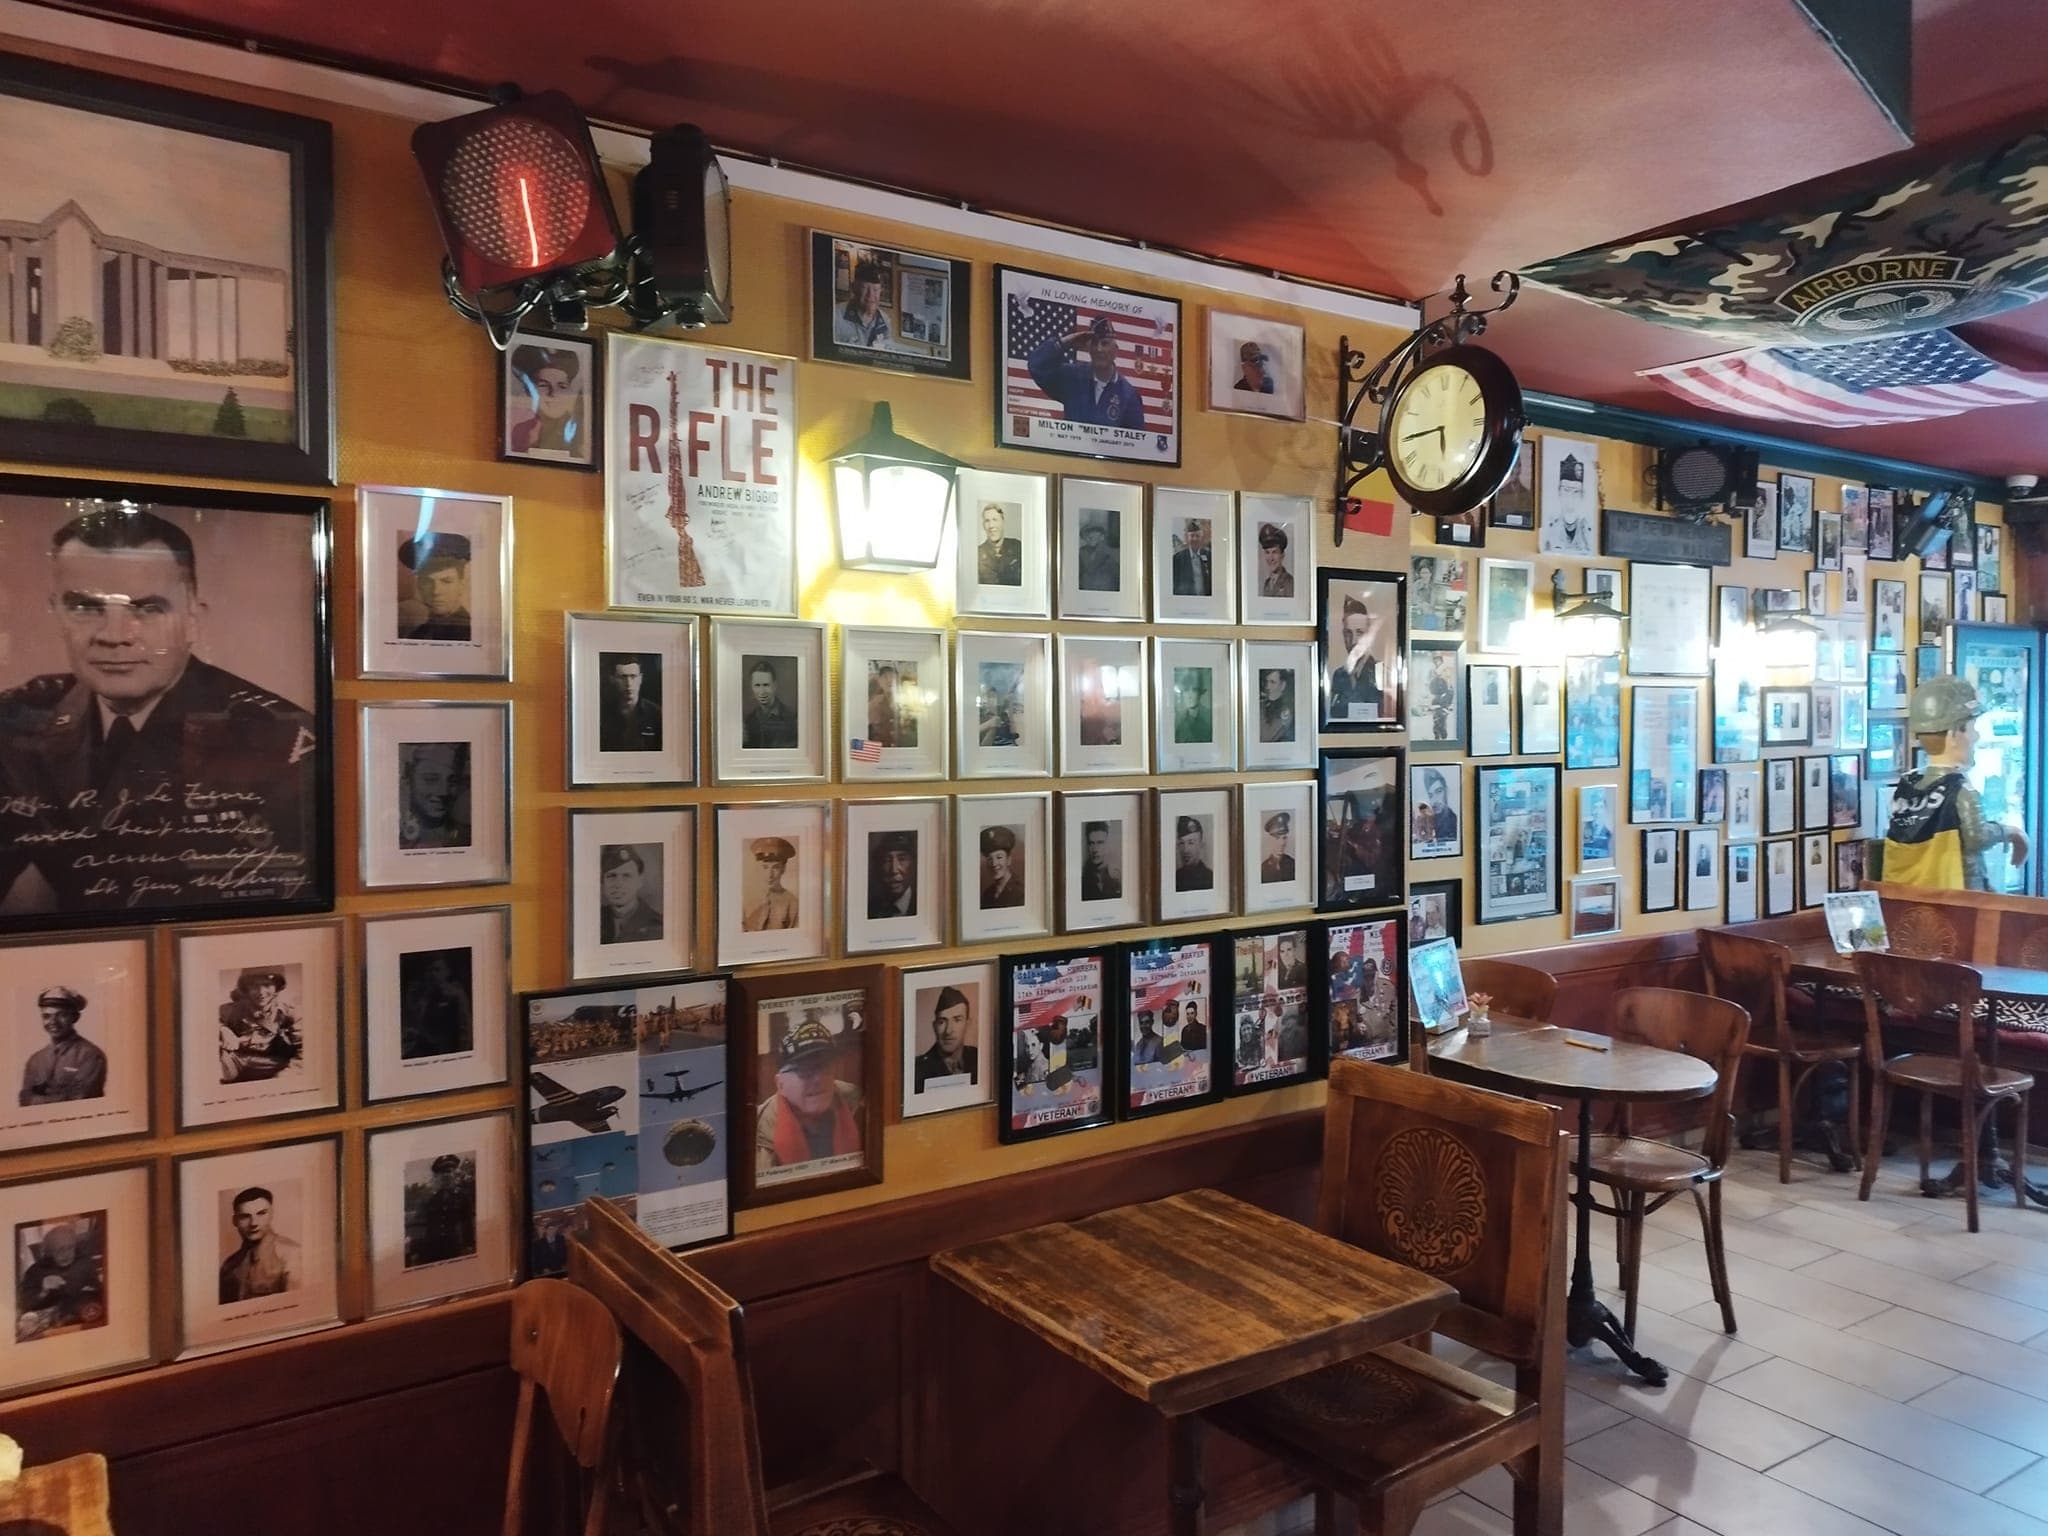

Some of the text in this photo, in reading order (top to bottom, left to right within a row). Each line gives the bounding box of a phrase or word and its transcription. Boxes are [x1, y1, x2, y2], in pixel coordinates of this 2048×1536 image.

[1792, 259, 1947, 310] AIRBORNE
[1041, 288, 1052, 297] IN
[1055, 291, 1088, 304] LOVING
[1090, 297, 1130, 313] MEMORY
[706, 358, 778, 416] THE
[1038, 420, 1073, 432] MILTON
[1114, 429, 1147, 441] STALEY
[697, 484, 778, 504] ANDREW BIGGIO
[14, 825, 98, 844] with
[106, 816, 174, 839] best
